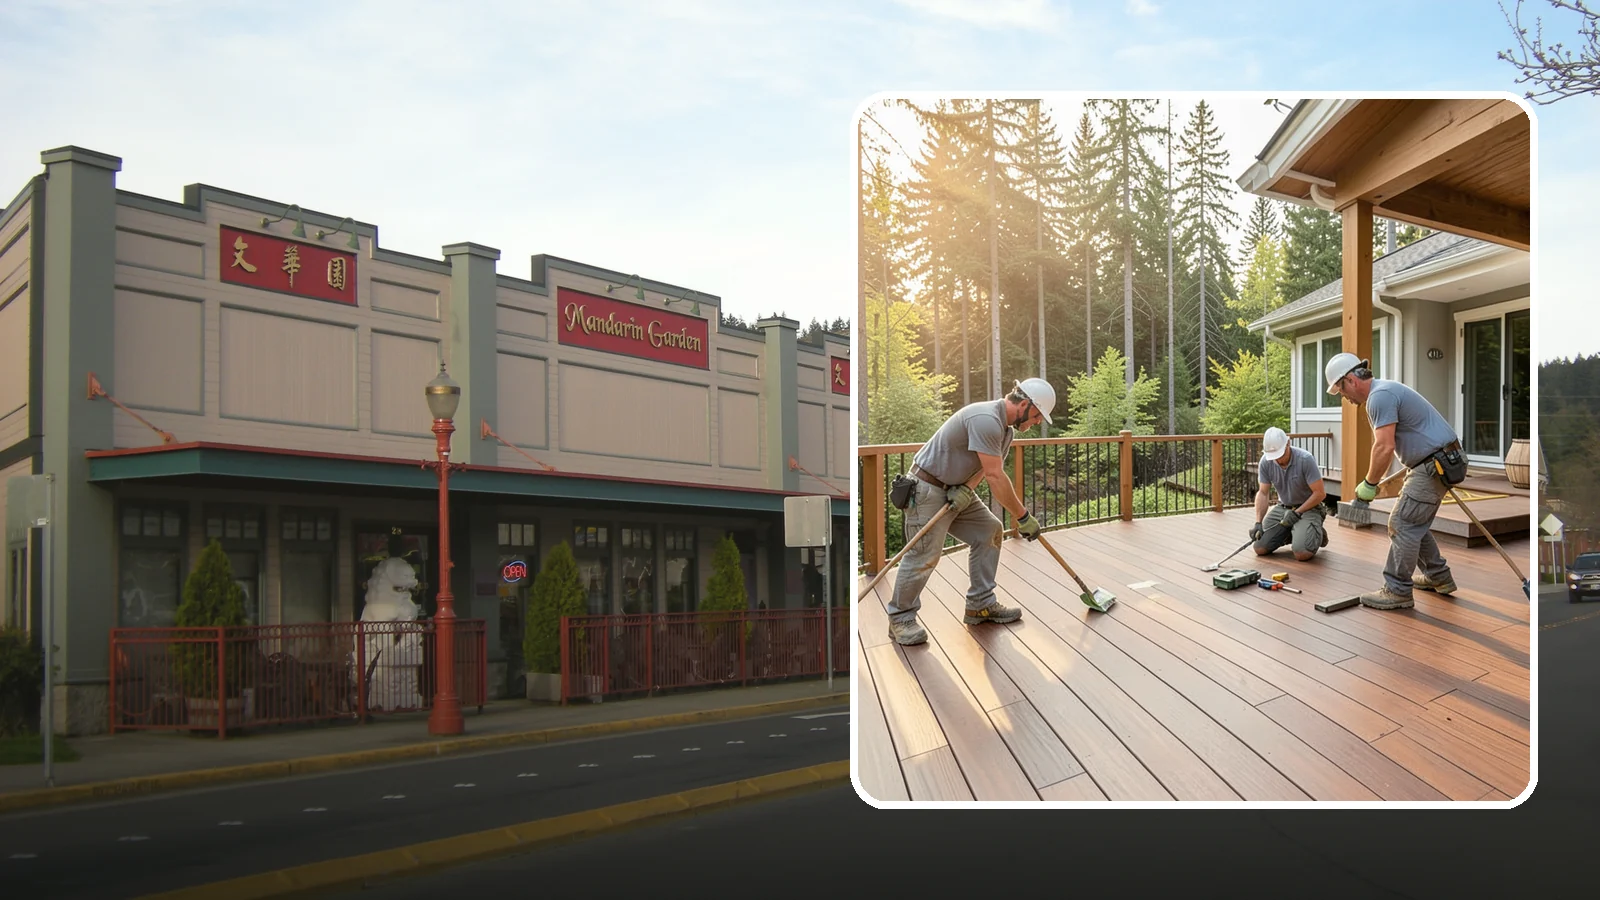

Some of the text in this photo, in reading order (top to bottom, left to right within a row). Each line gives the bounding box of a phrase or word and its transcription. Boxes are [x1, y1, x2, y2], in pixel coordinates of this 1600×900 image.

[564, 302, 702, 352] Mandarin Garden
[503, 565, 527, 578] OPEN
